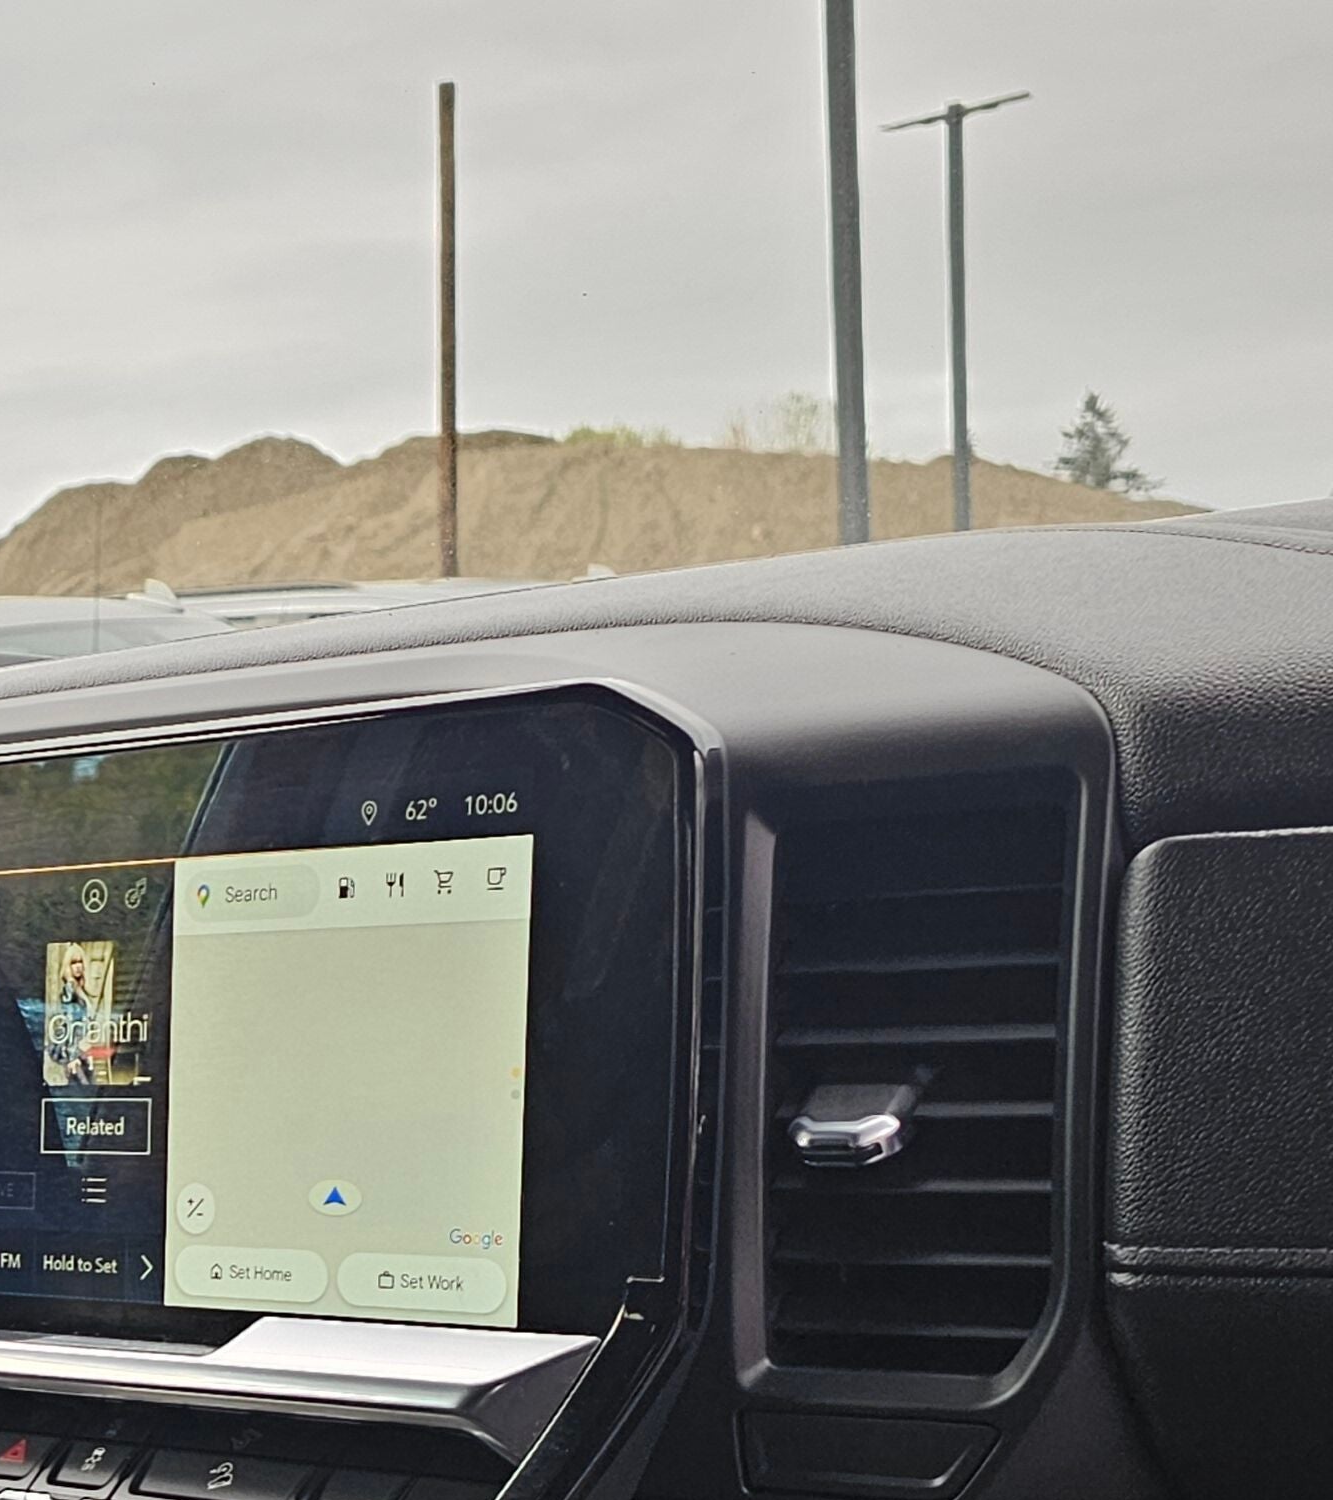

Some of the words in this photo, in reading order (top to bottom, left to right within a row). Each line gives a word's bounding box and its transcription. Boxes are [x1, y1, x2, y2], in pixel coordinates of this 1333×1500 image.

[405, 798, 437, 821] 62°
[464, 792, 518, 816] 10:06
[225, 884, 278, 903] Search
[48, 1011, 149, 1045] Orianthi
[66, 1117, 125, 1136] Related
[449, 1228, 503, 1250] Google
[0, 1253, 21, 1269] FM
[43, 1254, 74, 1272] Hold
[77, 1257, 92, 1272] to
[94, 1257, 118, 1274] Set
[229, 1265, 251, 1280] Set
[254, 1266, 292, 1282] Home
[400, 1273, 424, 1289] Set
[428, 1274, 464, 1292] Work
